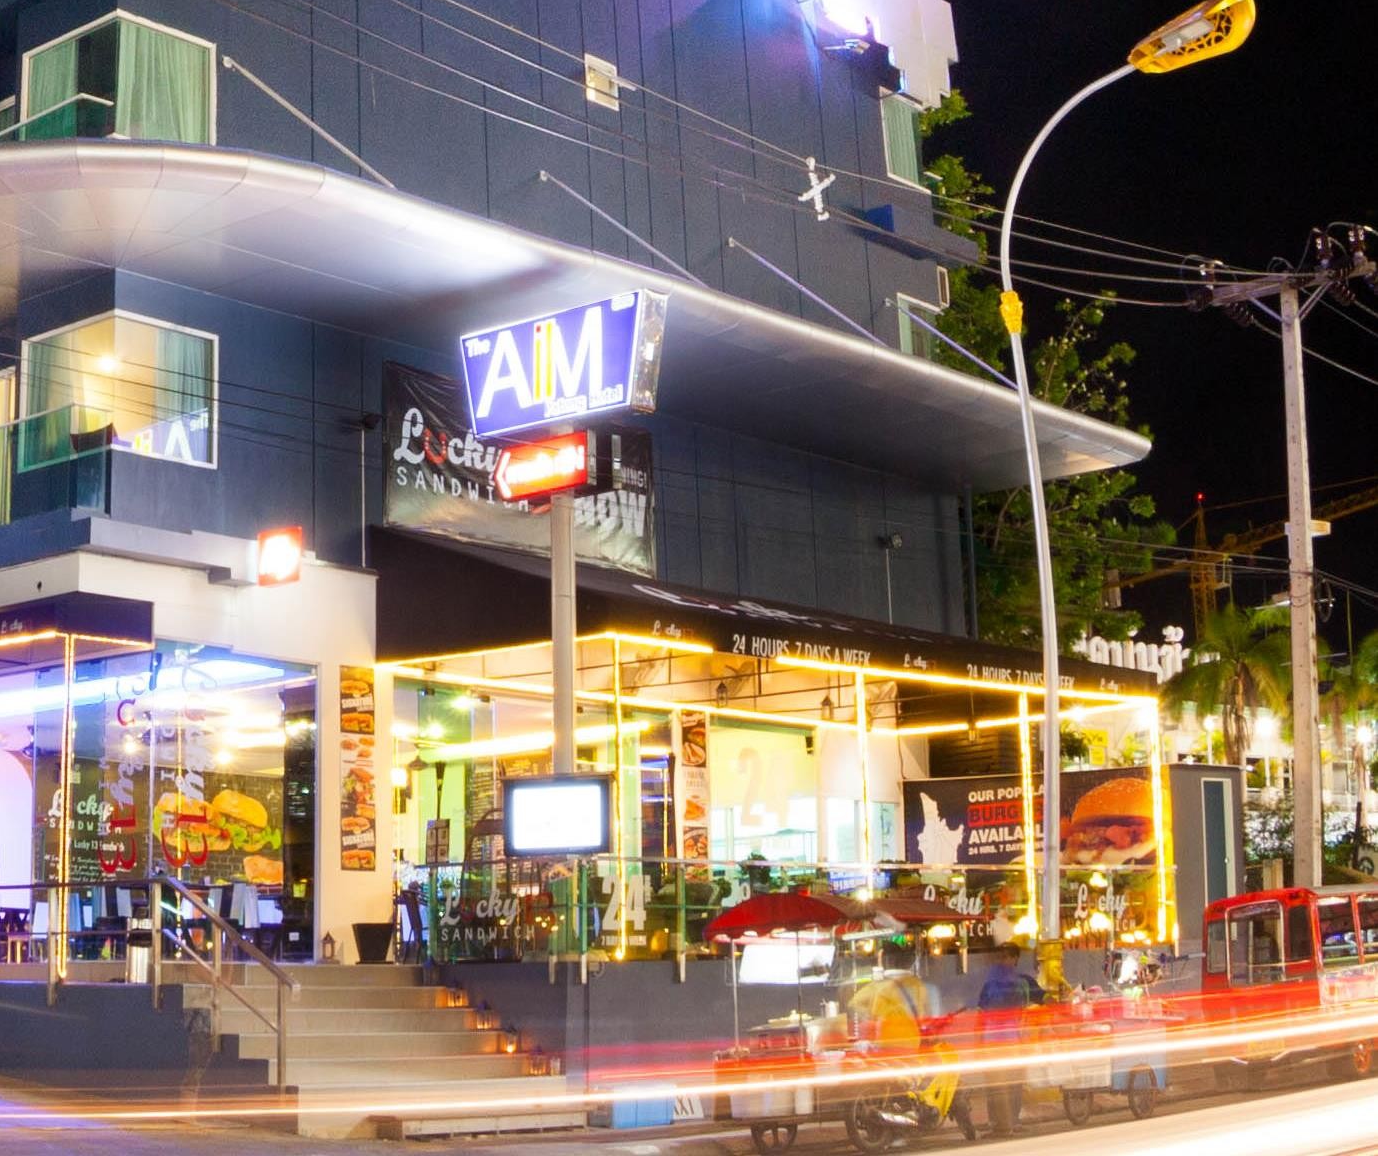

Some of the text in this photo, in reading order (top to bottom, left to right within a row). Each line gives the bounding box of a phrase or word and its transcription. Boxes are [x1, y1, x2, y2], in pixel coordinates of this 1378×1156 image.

[393, 407, 502, 486] Lucky
[397, 467, 530, 513] SANDWIH
[732, 633, 871, 666] 24 HOURS 7 DAYS A WEEK
[967, 664, 979, 680] 24
[982, 665, 1013, 684] HOURS
[1015, 670, 1021, 684] 7
[968, 784, 1046, 803] OUR POPLA
[969, 803, 1043, 823] BURG
[968, 824, 1045, 844] AVAILAL
[601, 874, 647, 931] 24
[441, 925, 536, 942] SANDWICH
